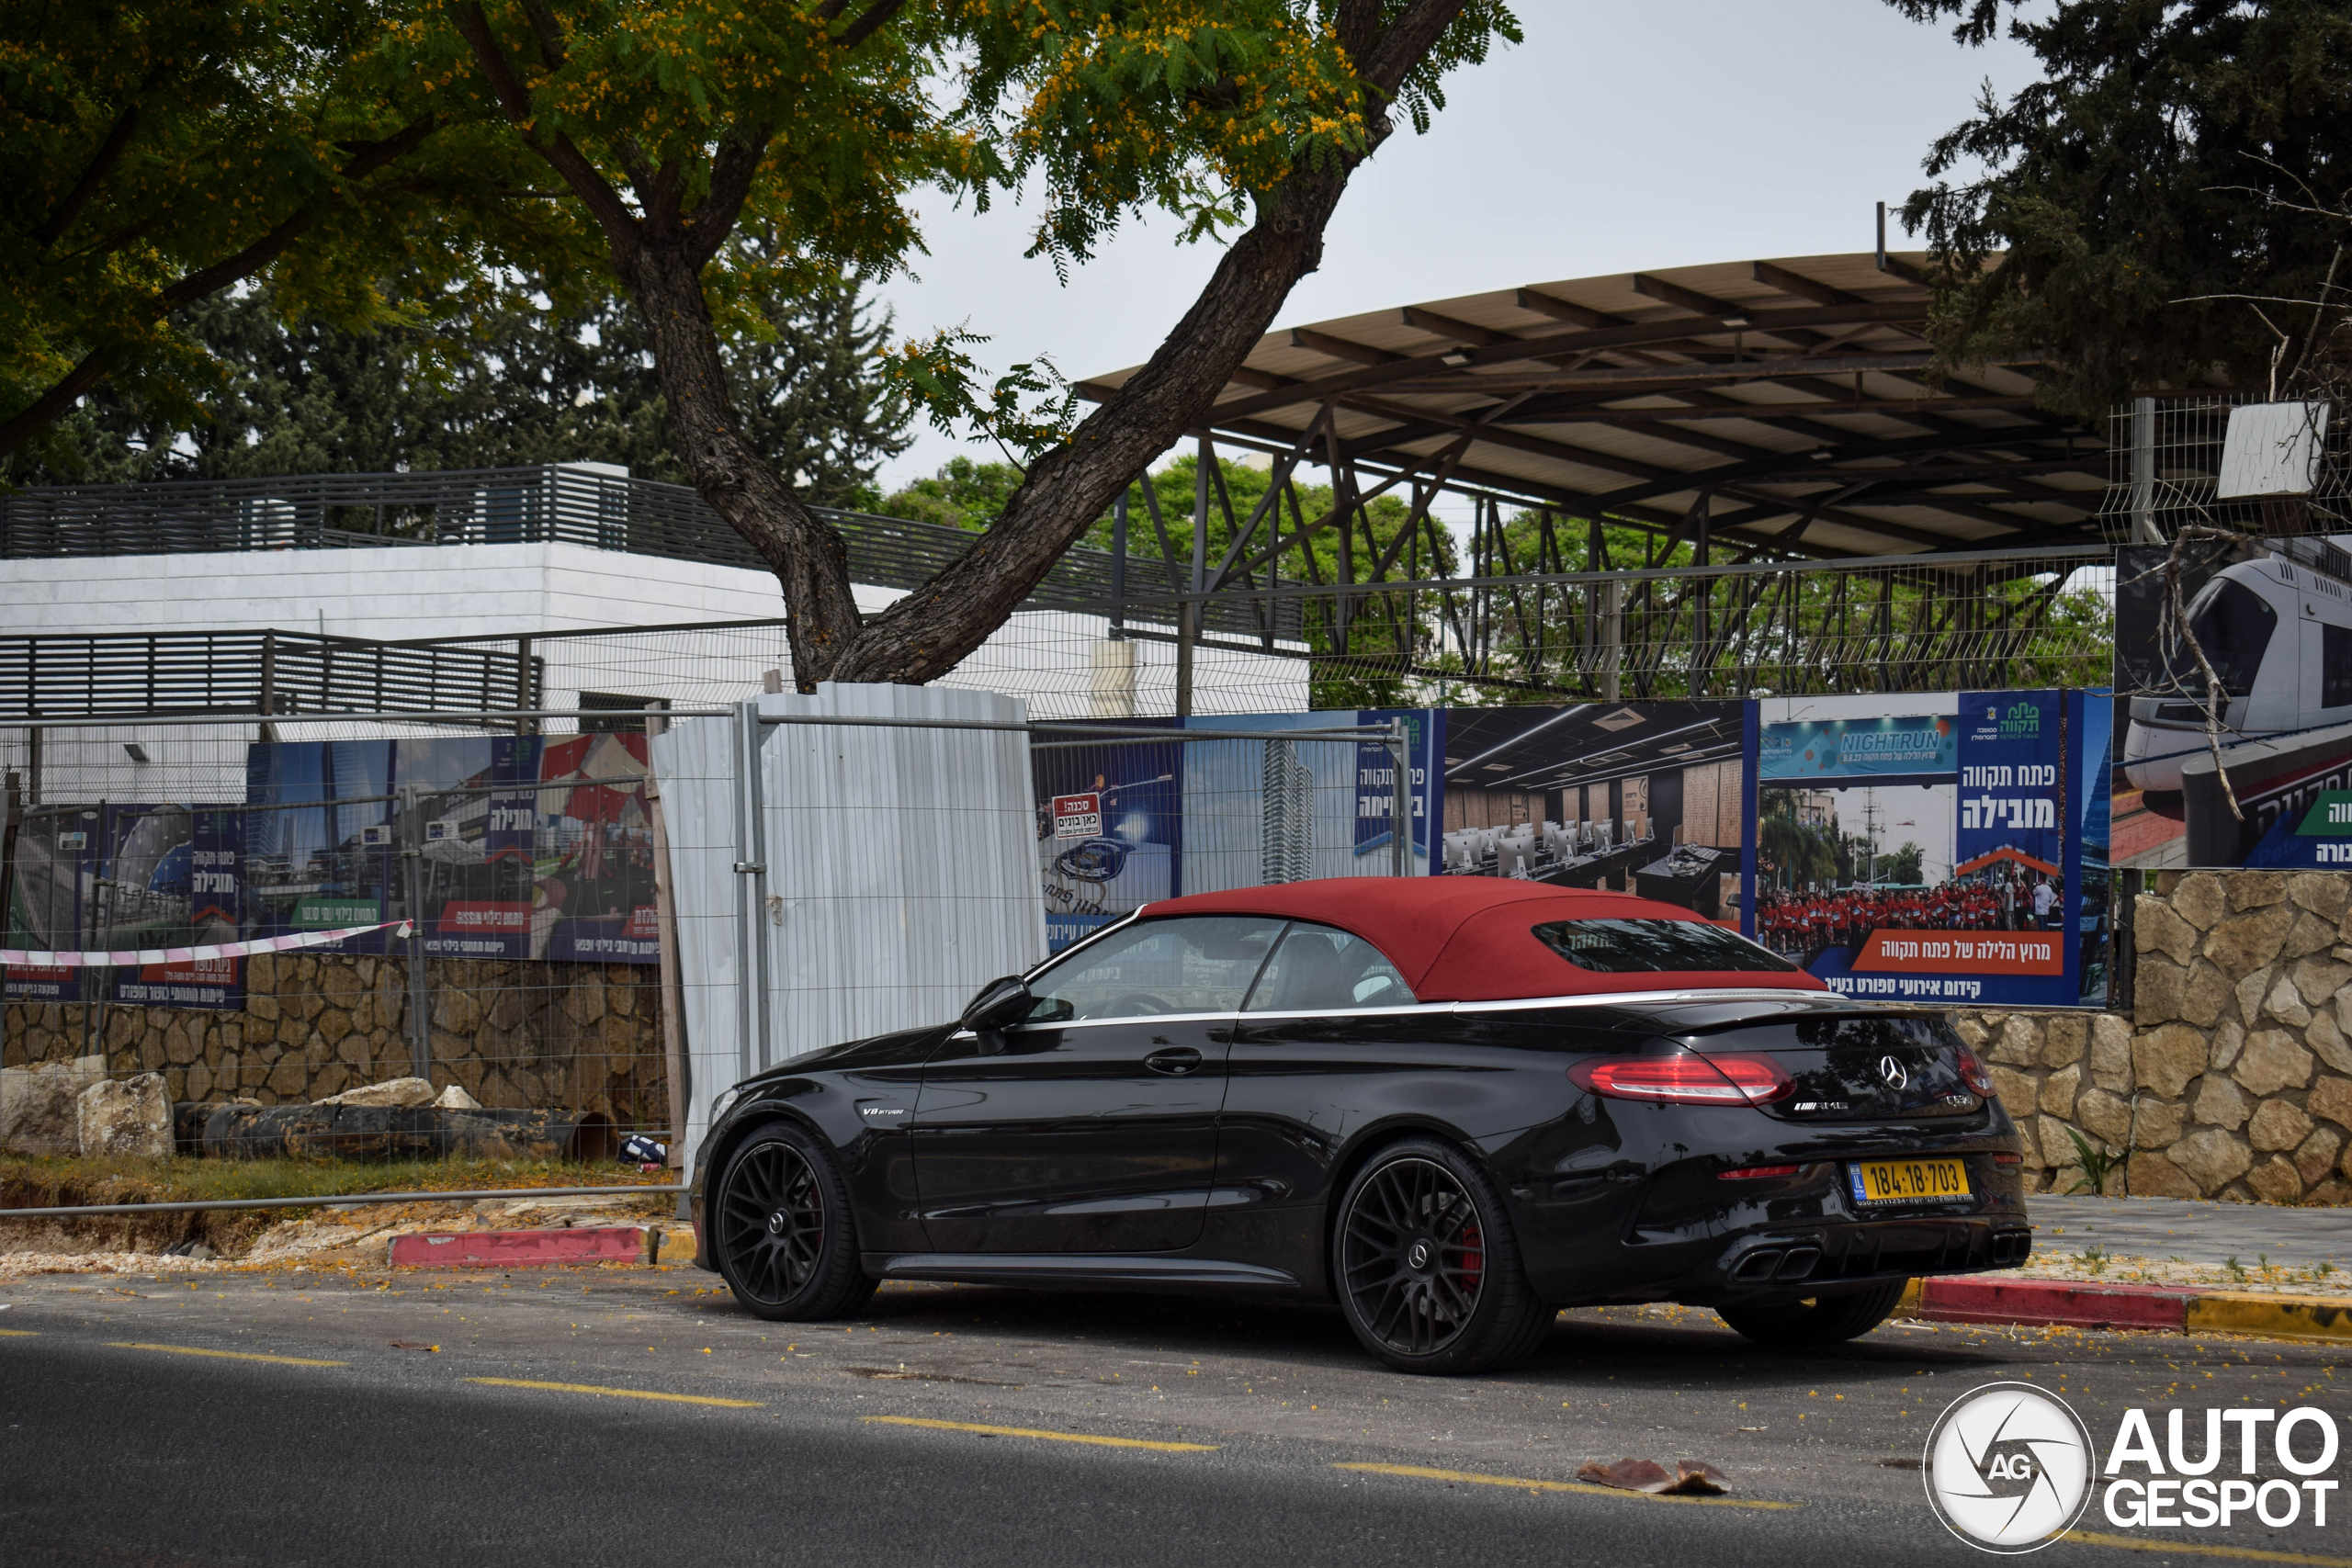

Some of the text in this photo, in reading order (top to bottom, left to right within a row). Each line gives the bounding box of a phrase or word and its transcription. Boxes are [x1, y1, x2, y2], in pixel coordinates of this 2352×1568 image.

[1841, 730, 1940, 752] NIGHTRUN
[1894, 751, 1903, 760] של
[1903, 751, 1920, 760] הלילה
[1921, 751, 1936, 761] מרוץ
[1962, 764, 2055, 791] פתח תקווה
[1064, 800, 1090, 813] סכנה!
[1962, 795, 2054, 829] מובילה
[490, 806, 533, 831] מובילה
[1058, 815, 1097, 828] כאן בונים
[193, 870, 234, 893] מובילה
[1881, 939, 2051, 964] מרוץ הלילה של פתח תקווה
[1856, 977, 1895, 994] ספורט
[1899, 978, 1940, 996] אירועי
[1944, 980, 1981, 999] קידום
